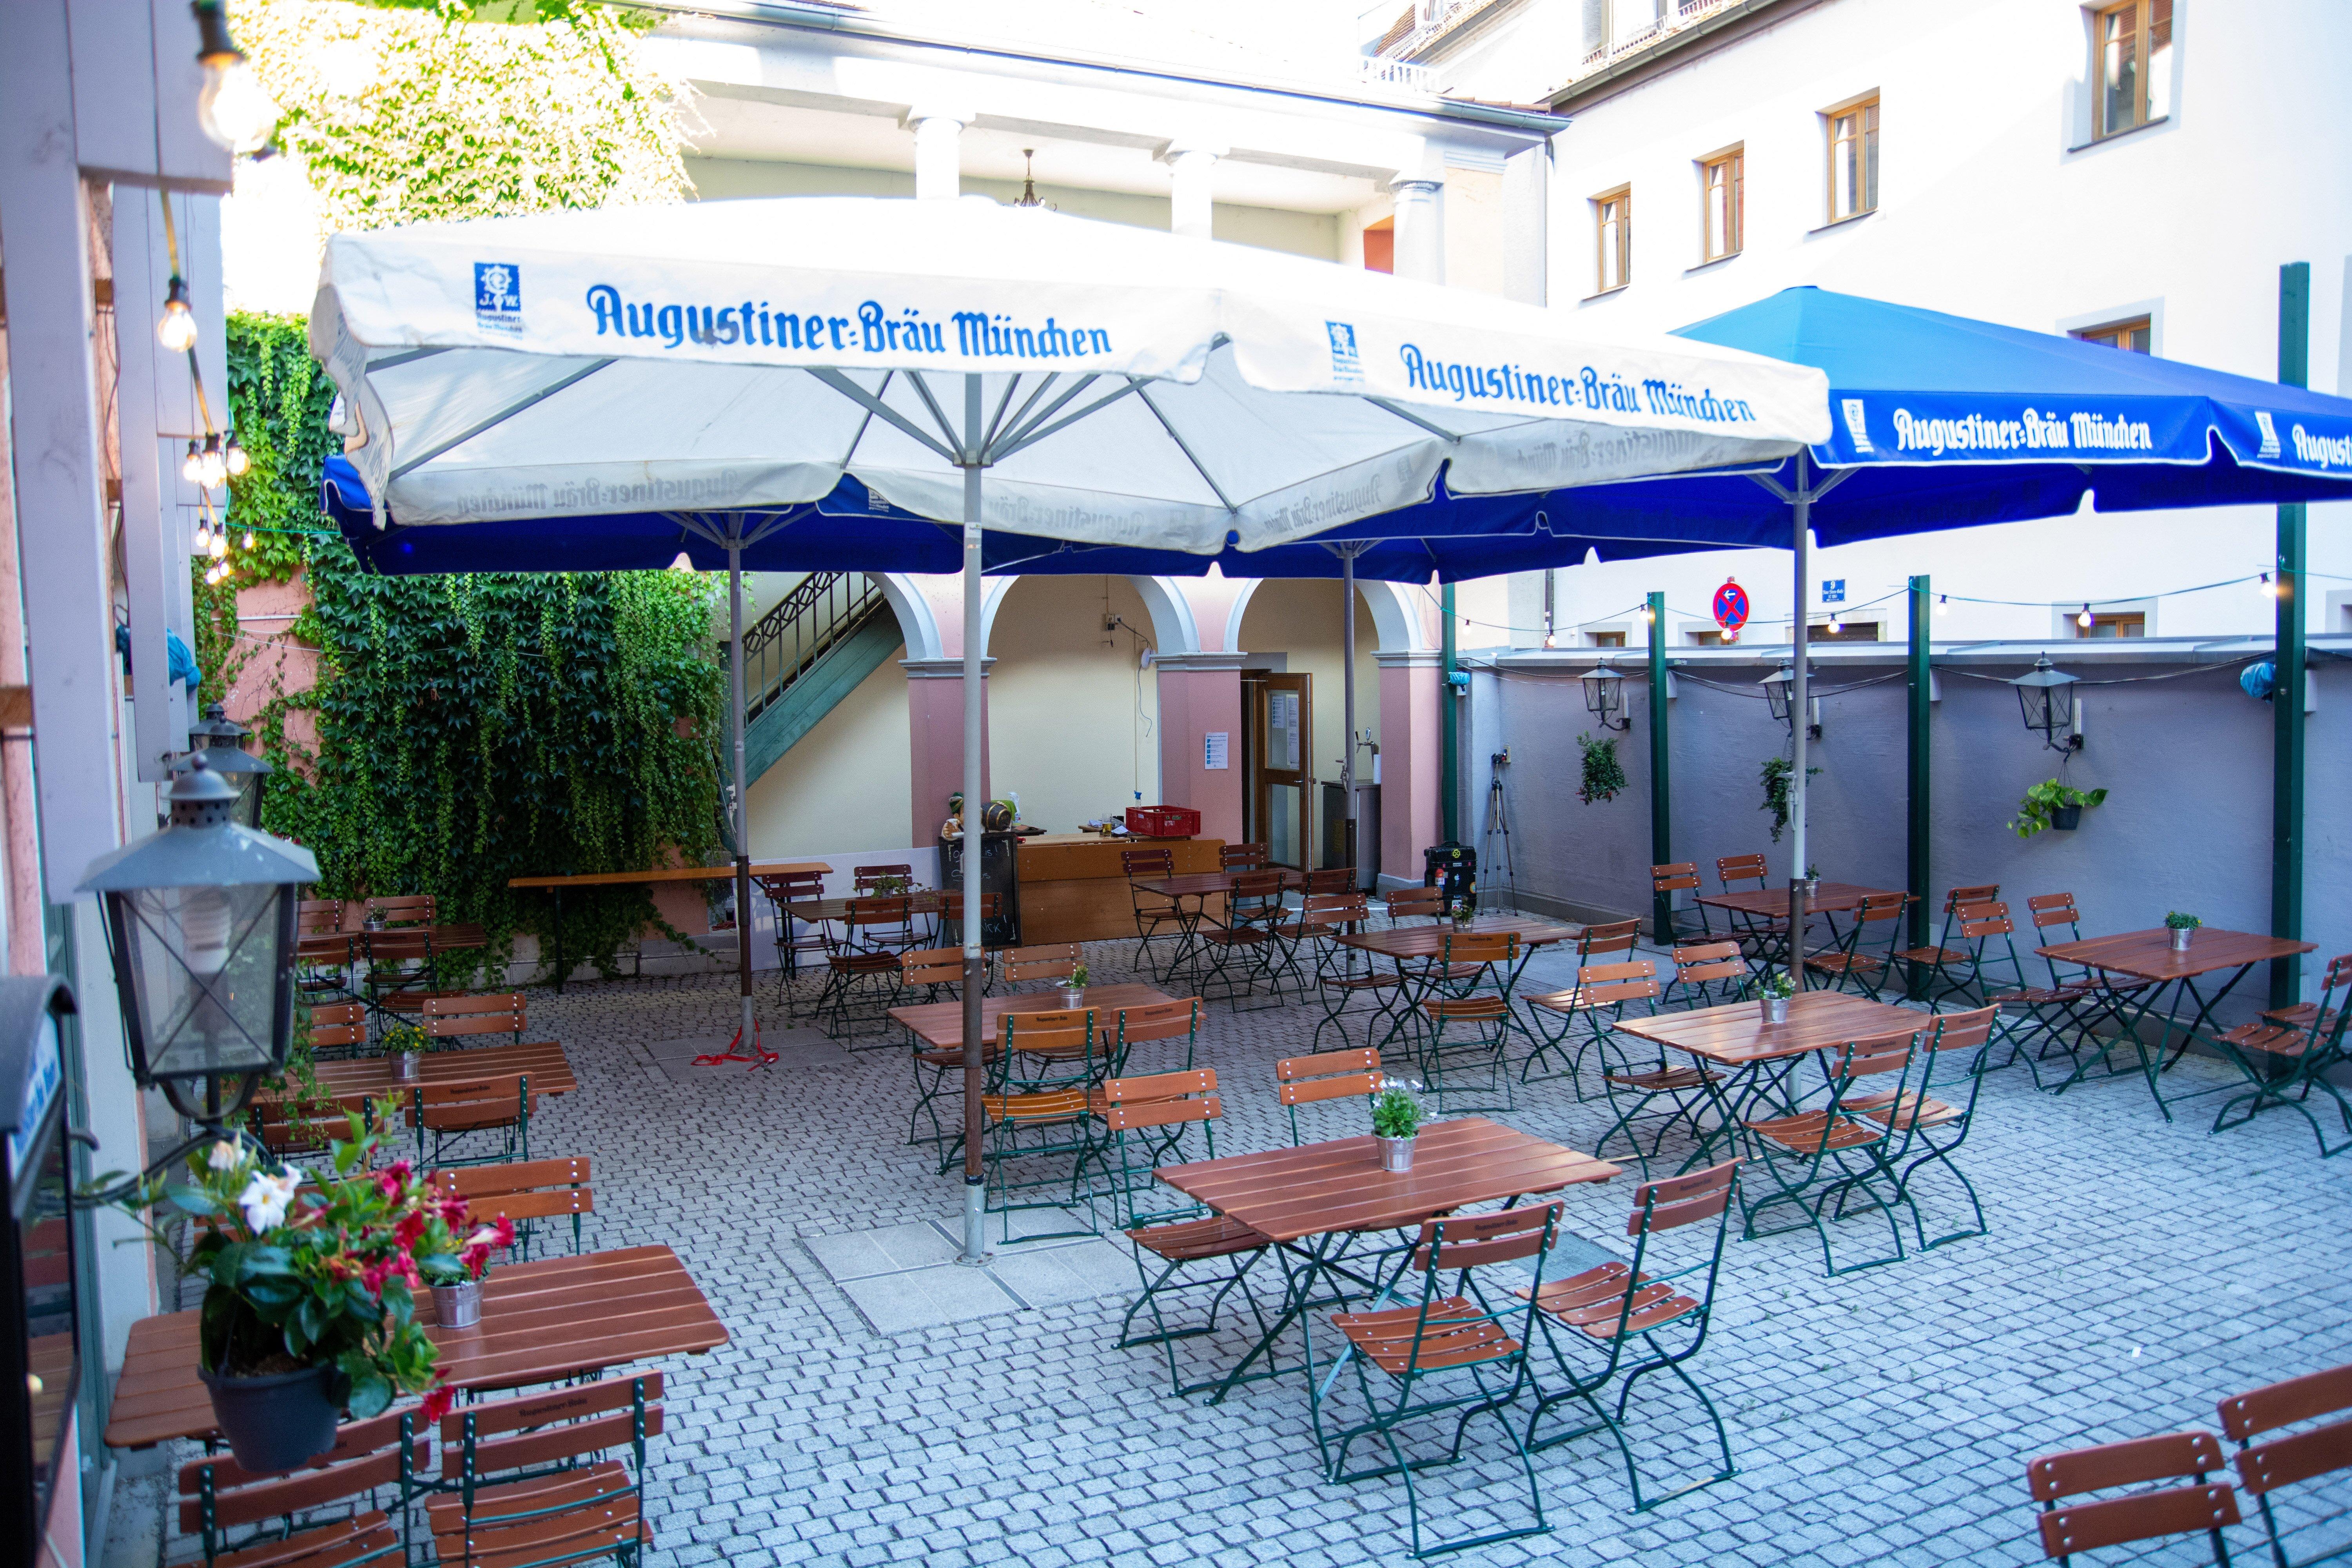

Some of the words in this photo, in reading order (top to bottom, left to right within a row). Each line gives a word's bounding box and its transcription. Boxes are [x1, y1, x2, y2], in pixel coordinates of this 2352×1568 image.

[951, 311, 1112, 358] München
[1641, 379, 1757, 423] München
[2070, 412, 2152, 450] München
[2292, 423, 2352, 470] August
[1830, 581, 1835, 590] 9
